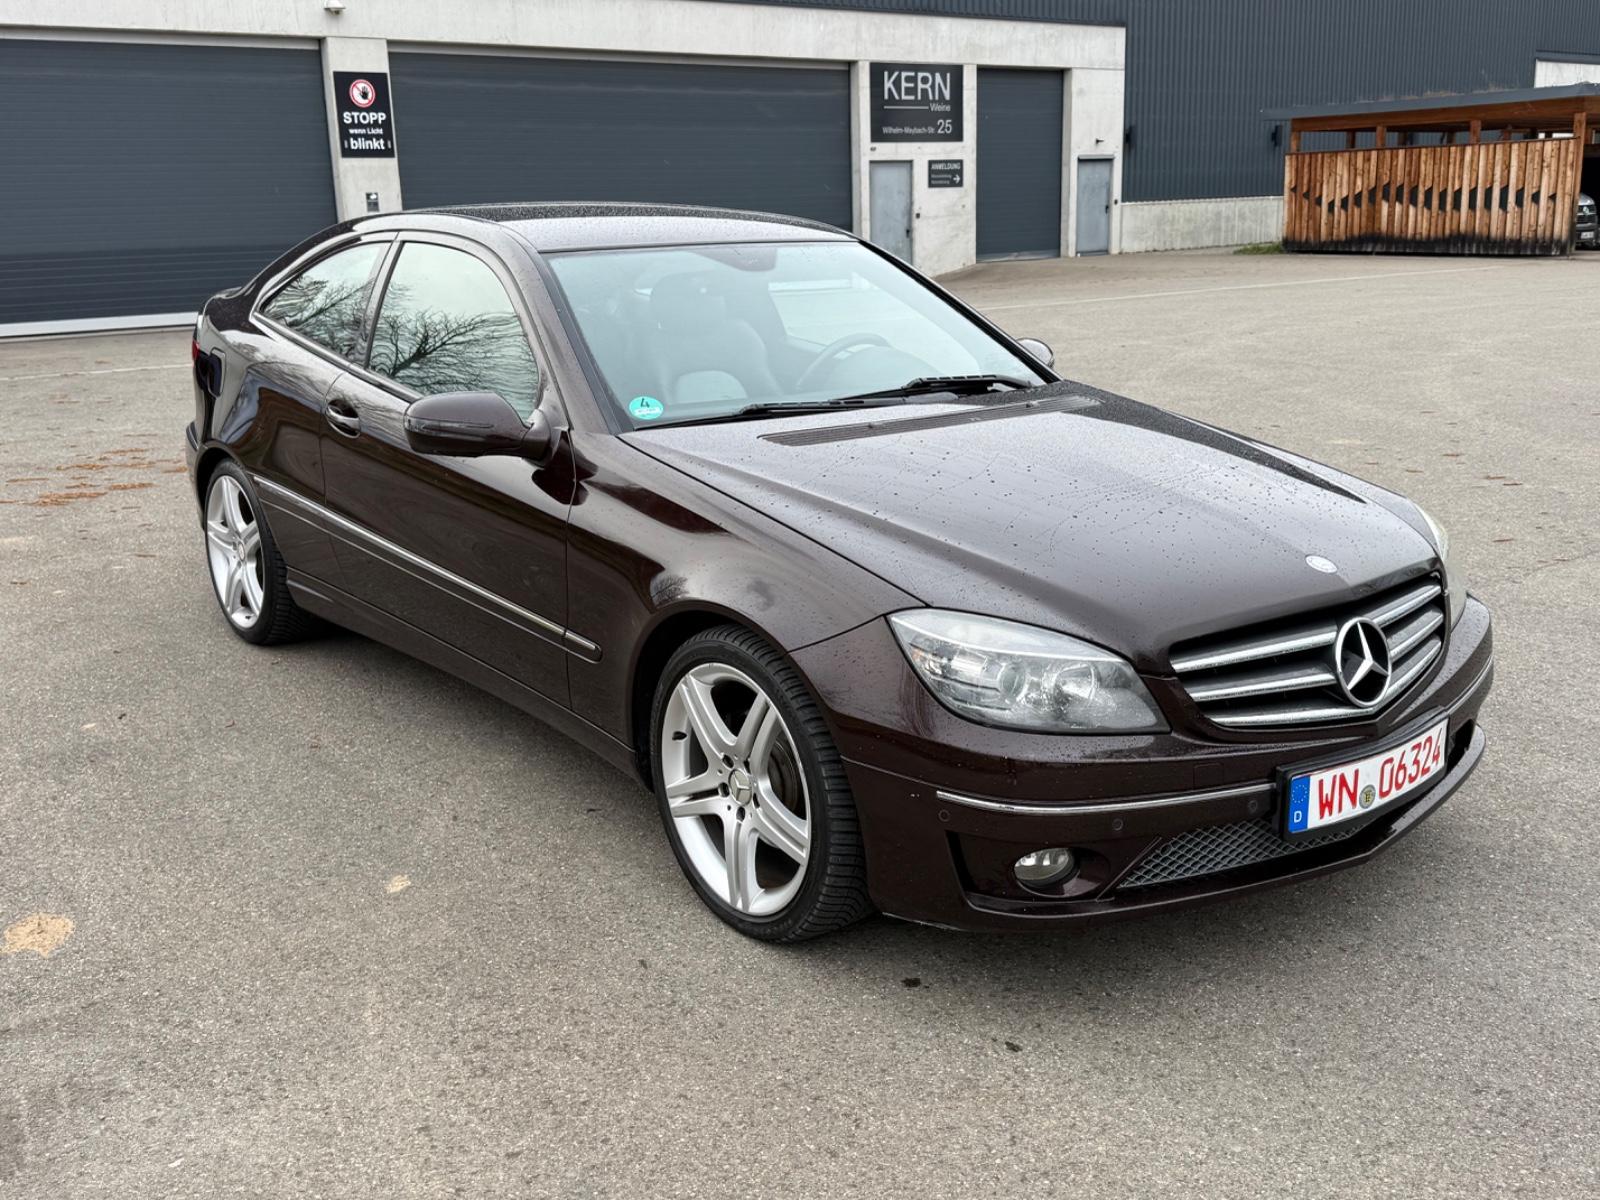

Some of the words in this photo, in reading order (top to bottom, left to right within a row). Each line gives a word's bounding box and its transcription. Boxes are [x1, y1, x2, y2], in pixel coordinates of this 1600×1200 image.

[883, 71, 951, 101] KERN
[929, 103, 951, 112] Weine
[343, 111, 387, 125] STOPP
[367, 127, 383, 135] Licht
[937, 119, 953, 134] 25
[350, 138, 386, 150] blinkt
[640, 397, 650, 408] 4
[1318, 768, 1360, 820] WN
[1378, 727, 1443, 800] 06324
[1293, 810, 1303, 823] D
